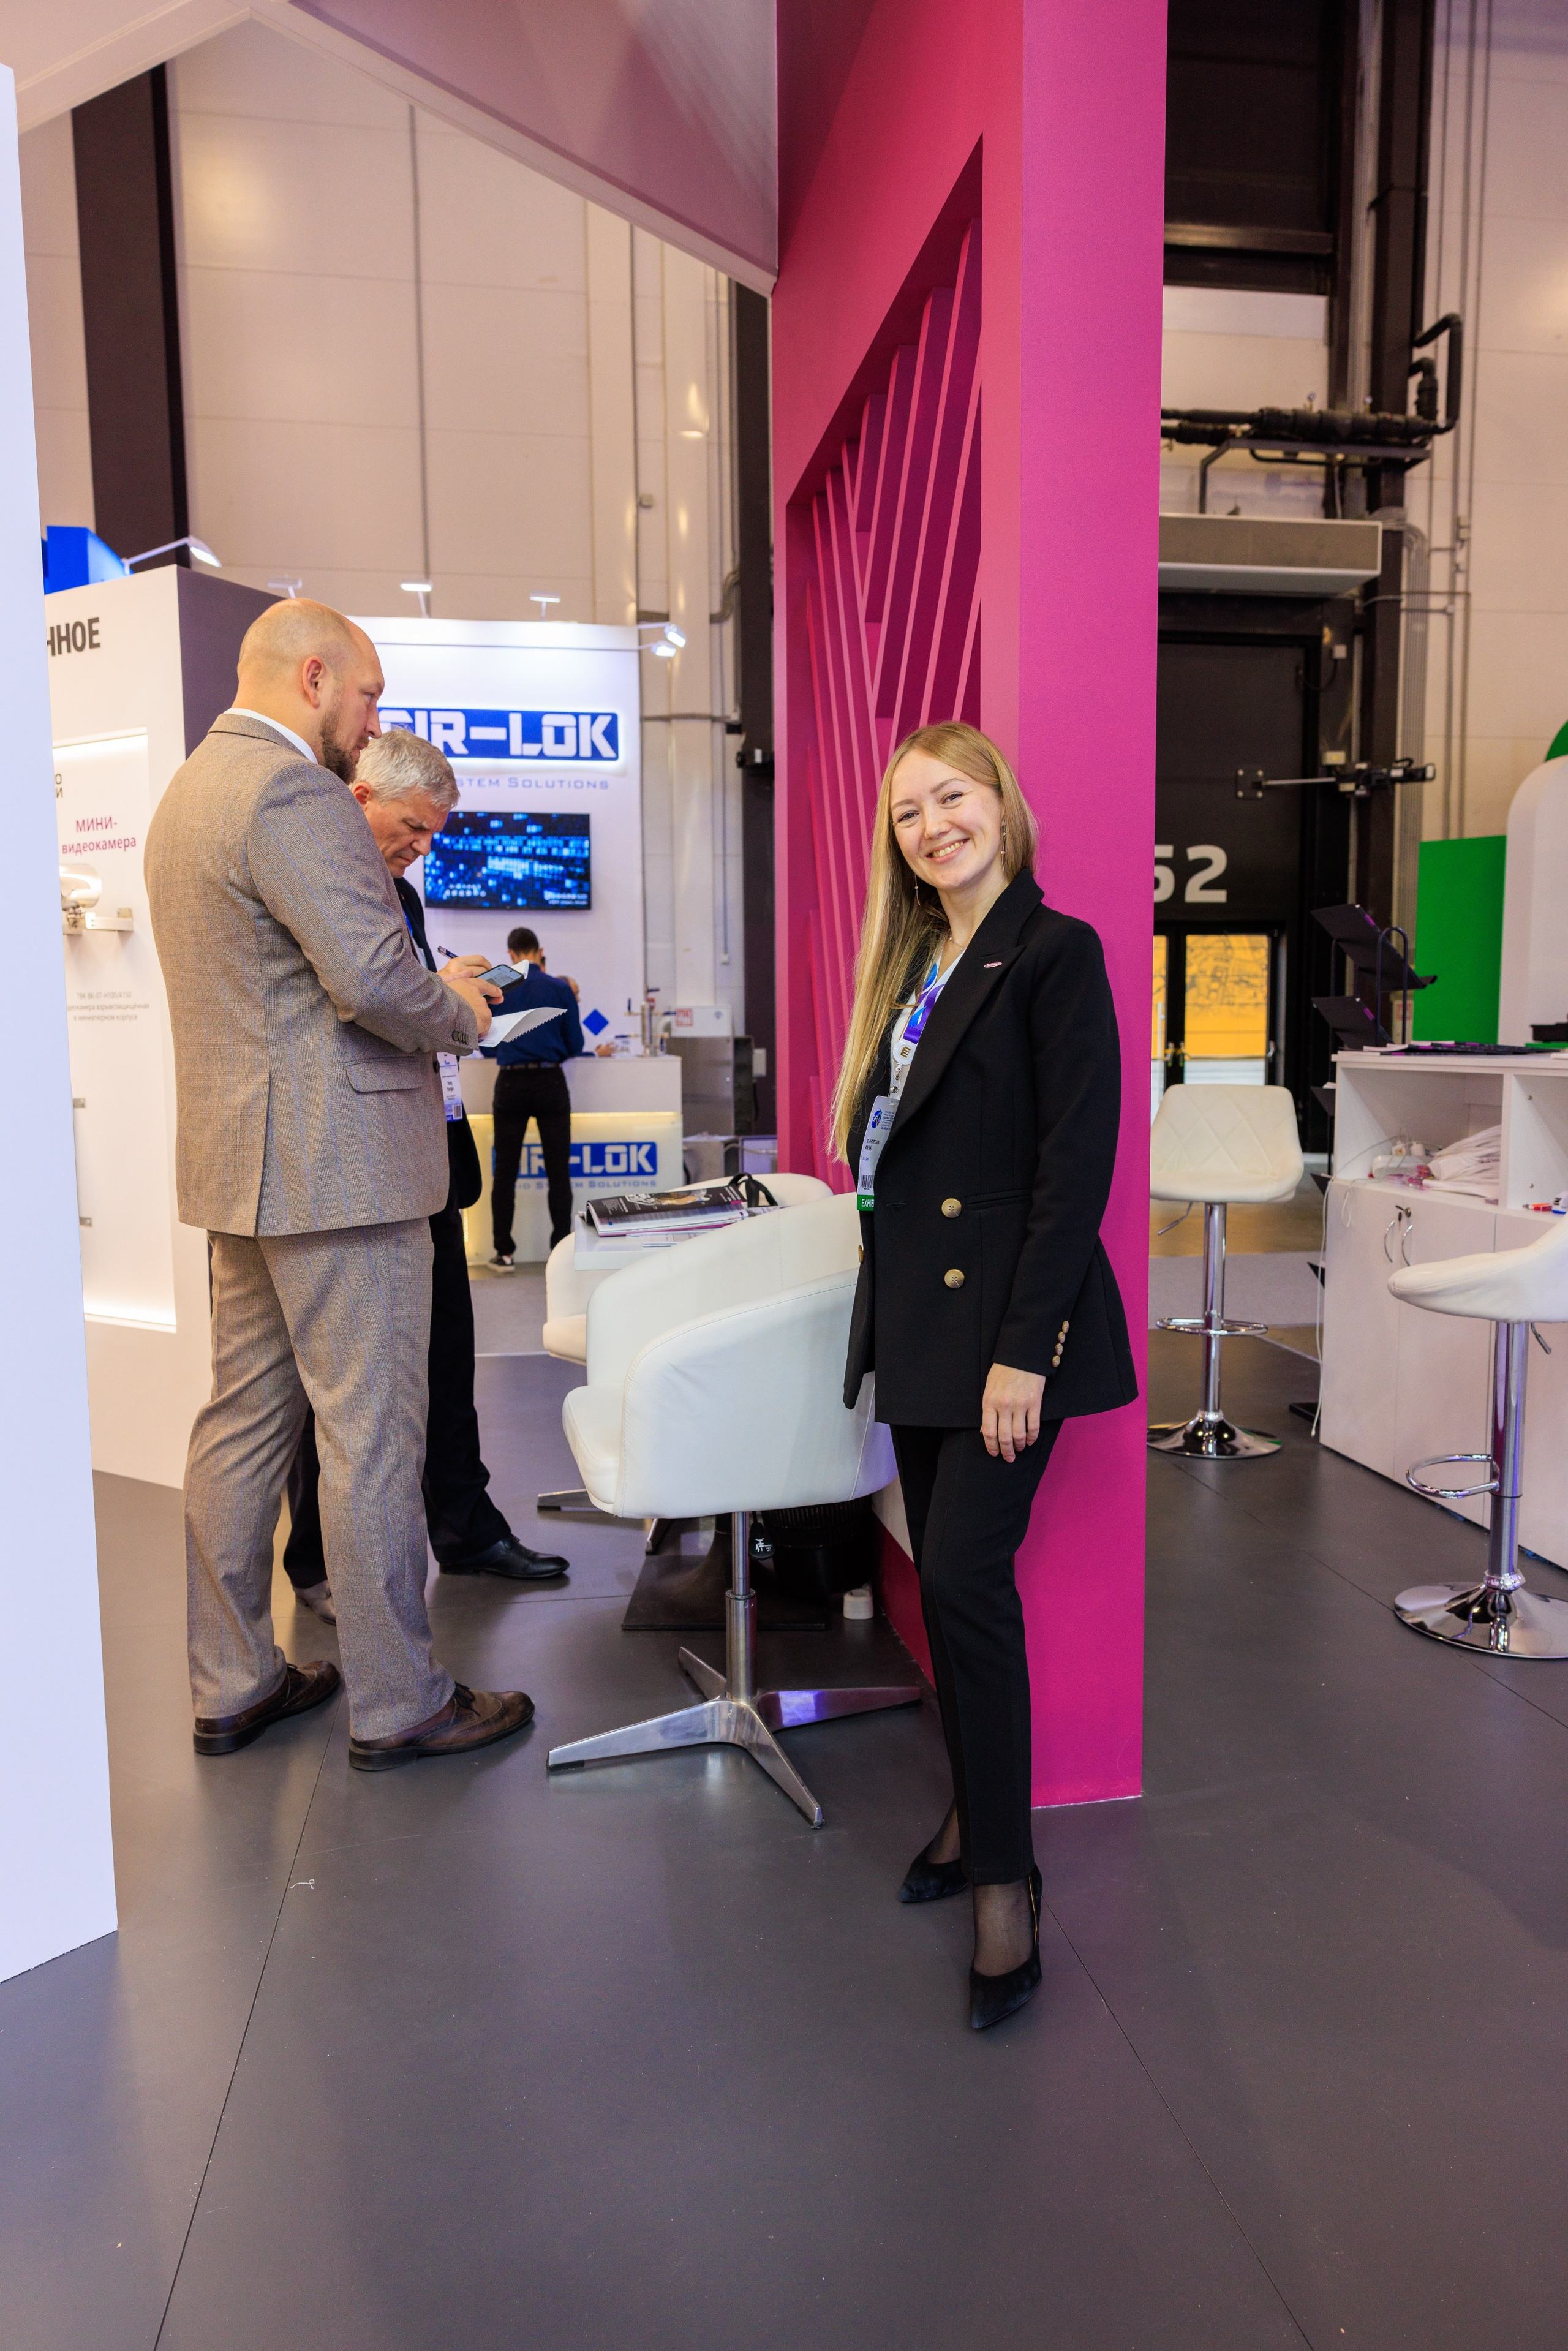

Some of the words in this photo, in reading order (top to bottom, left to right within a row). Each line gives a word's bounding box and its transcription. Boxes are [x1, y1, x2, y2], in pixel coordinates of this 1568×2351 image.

[508, 777, 609, 790] SOLUTIONS
[76, 817, 117, 832] МИНИ-
[62, 837, 136, 855] видеокамера
